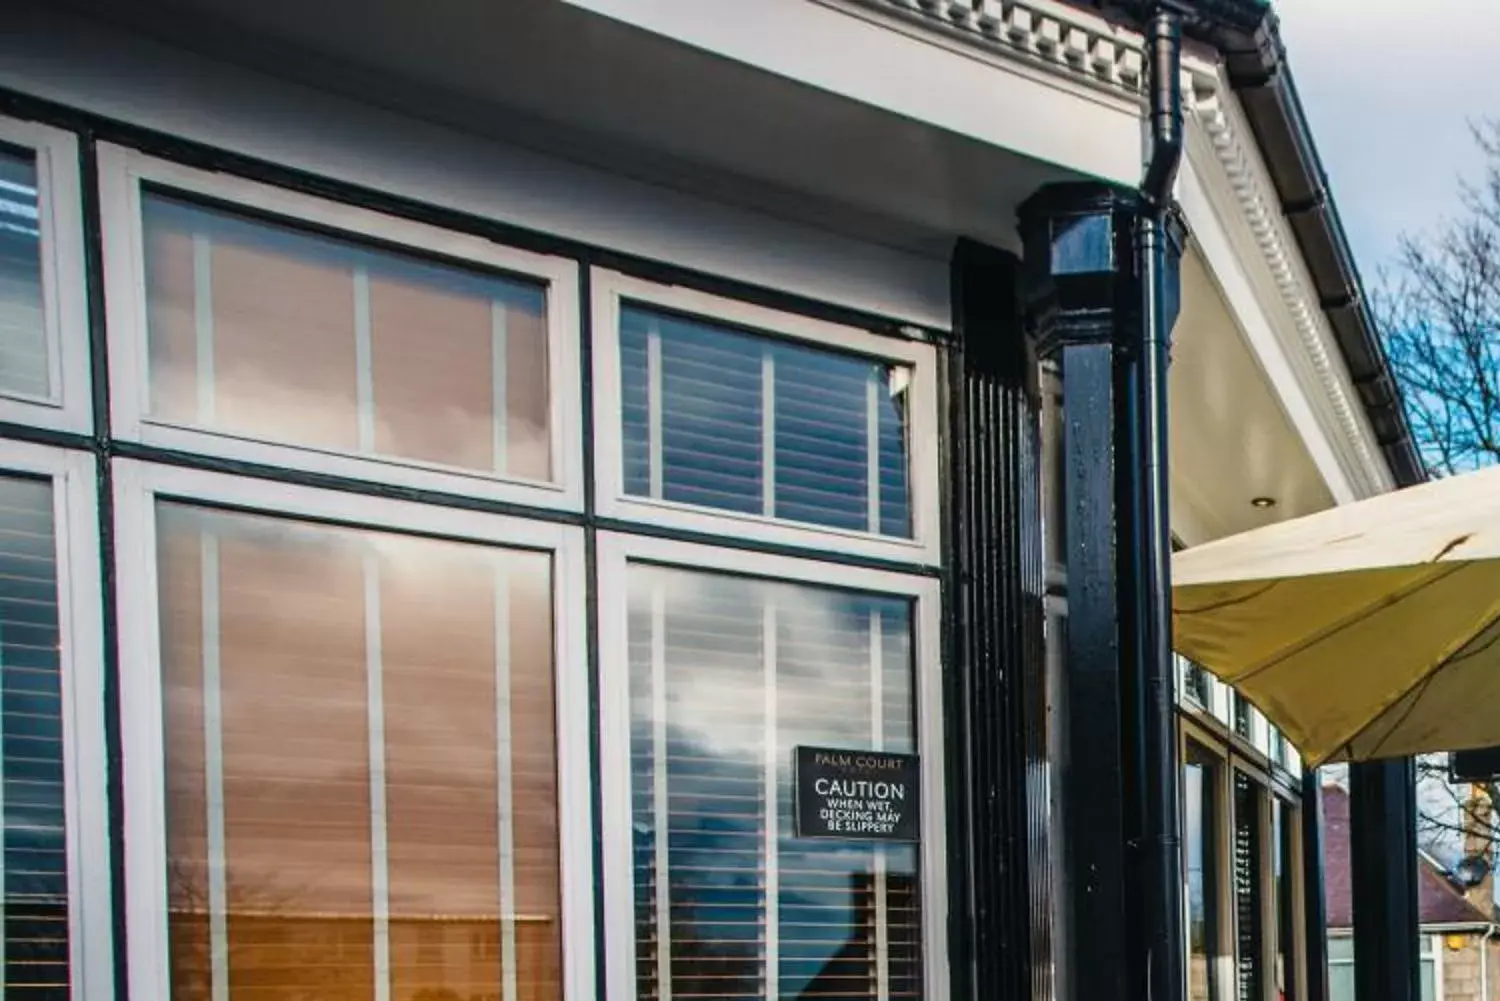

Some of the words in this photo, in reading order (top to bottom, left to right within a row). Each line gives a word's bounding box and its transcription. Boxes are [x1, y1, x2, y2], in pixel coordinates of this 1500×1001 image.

[815, 753, 851, 766] PALM
[856, 757, 904, 769] COURT
[815, 778, 904, 799] CAUTION
[826, 797, 863, 809] WHEN
[820, 808, 872, 821] DECKING
[876, 811, 901, 823] MAY
[828, 820, 842, 831] BE
[845, 822, 895, 833] SLIPPERY
